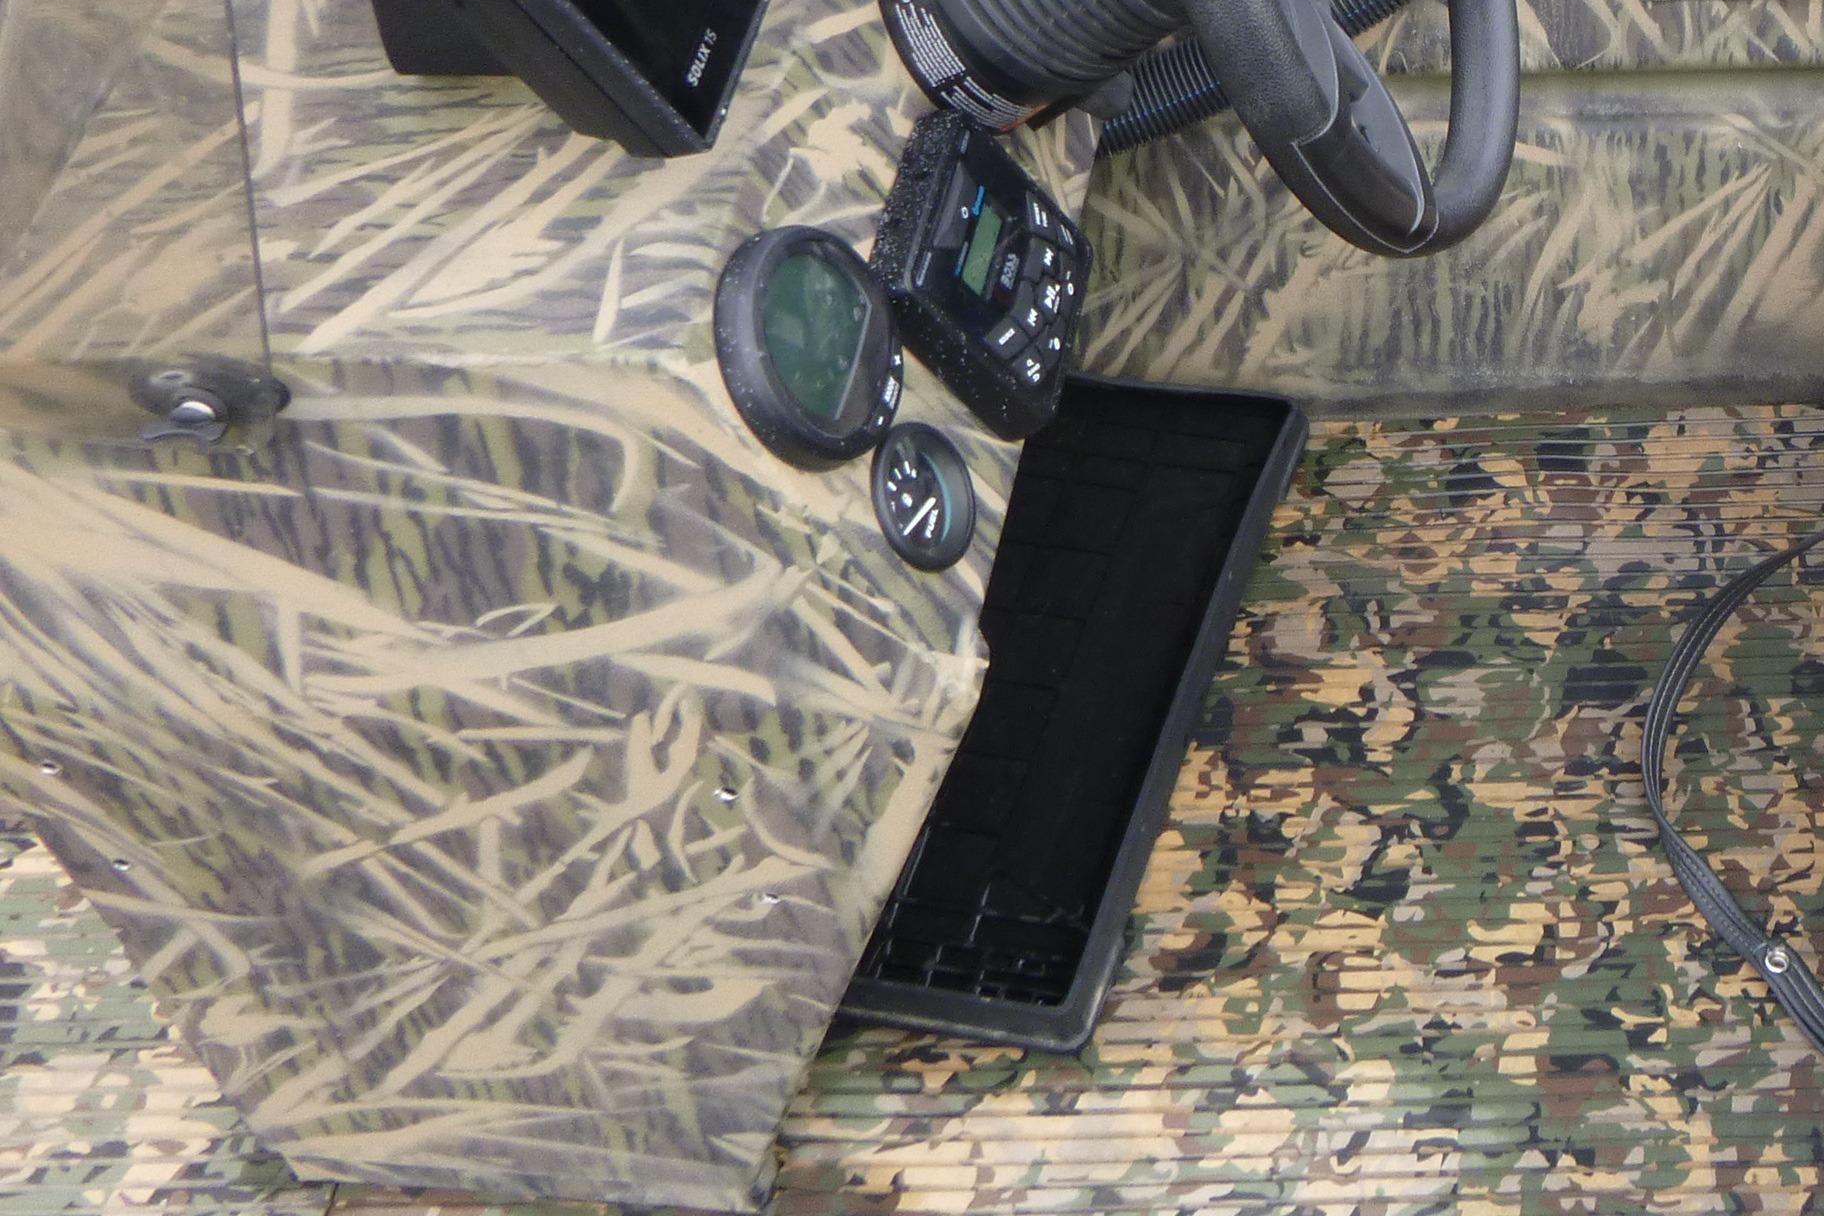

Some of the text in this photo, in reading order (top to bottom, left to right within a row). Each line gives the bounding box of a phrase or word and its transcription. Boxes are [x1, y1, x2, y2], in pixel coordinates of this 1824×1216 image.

[687, 28, 717, 87] SOLIX 15
[924, 508, 939, 539] FUEL
